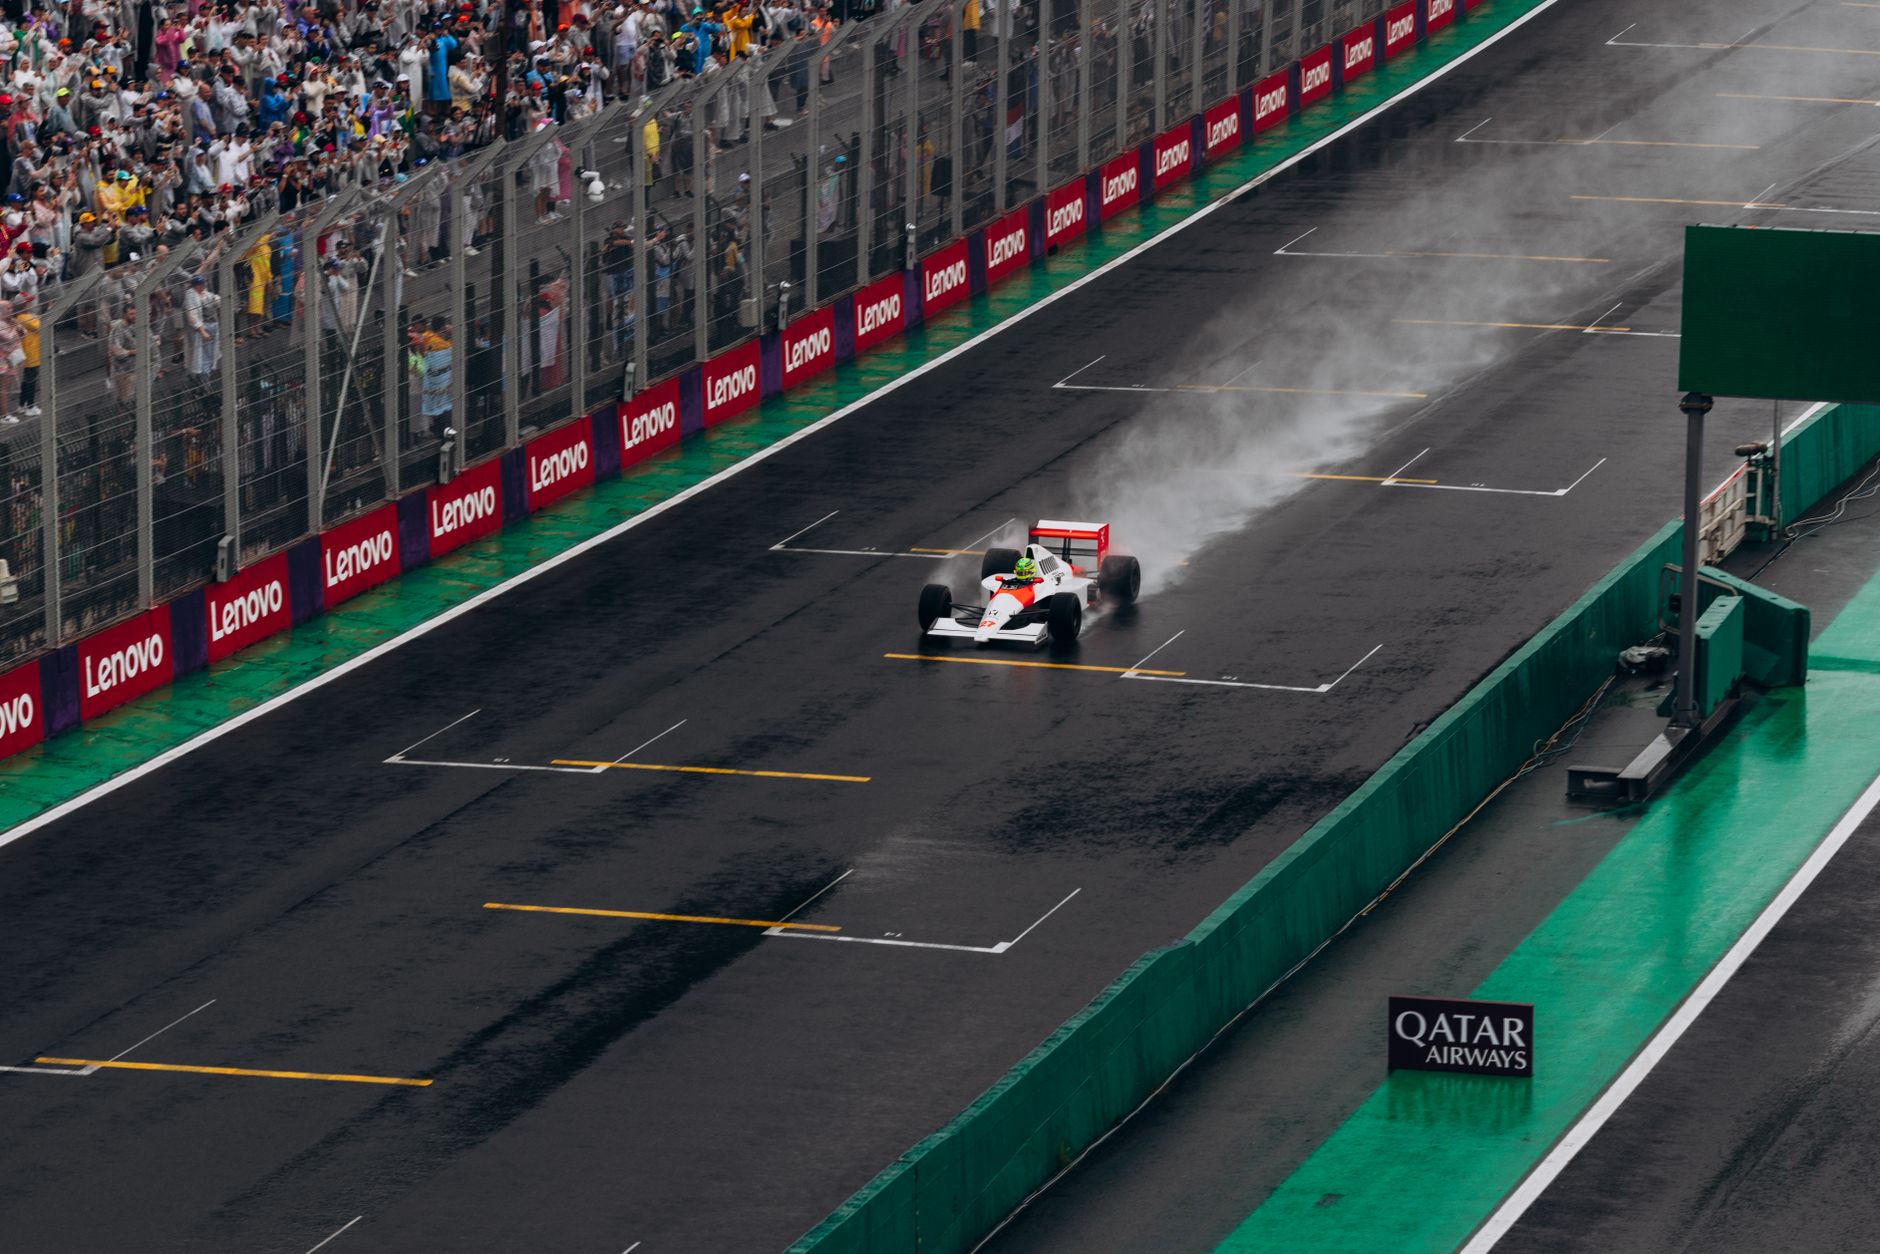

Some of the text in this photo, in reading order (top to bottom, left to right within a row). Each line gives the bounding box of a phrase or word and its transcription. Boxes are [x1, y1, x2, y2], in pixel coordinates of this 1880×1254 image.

[1387, 13, 1414, 46] Lenovo
[1345, 35, 1373, 70] Lenovo
[1301, 60, 1330, 94] Lenovo
[1255, 86, 1287, 121] Lenovo
[1206, 112, 1238, 149] Lenovo
[1156, 140, 1189, 177] Lenovo
[1102, 168, 1137, 206] Lenovo
[1046, 198, 1083, 238] Lenovo
[987, 228, 1026, 269] Lenovo
[925, 260, 967, 302] Lenovo
[857, 293, 901, 337] Lenovo
[784, 327, 831, 373] Lenovo
[706, 364, 756, 410] Lenovo
[622, 402, 676, 450] Lenovo
[530, 440, 588, 493] Lenovo
[432, 485, 496, 538] Lenovo
[325, 530, 393, 588] Lenovo
[210, 579, 283, 642] Lenovo
[85, 633, 164, 699] Lenovo
[1395, 1011, 1526, 1047] QATAR
[1425, 1045, 1527, 1070] AIRWAYS
